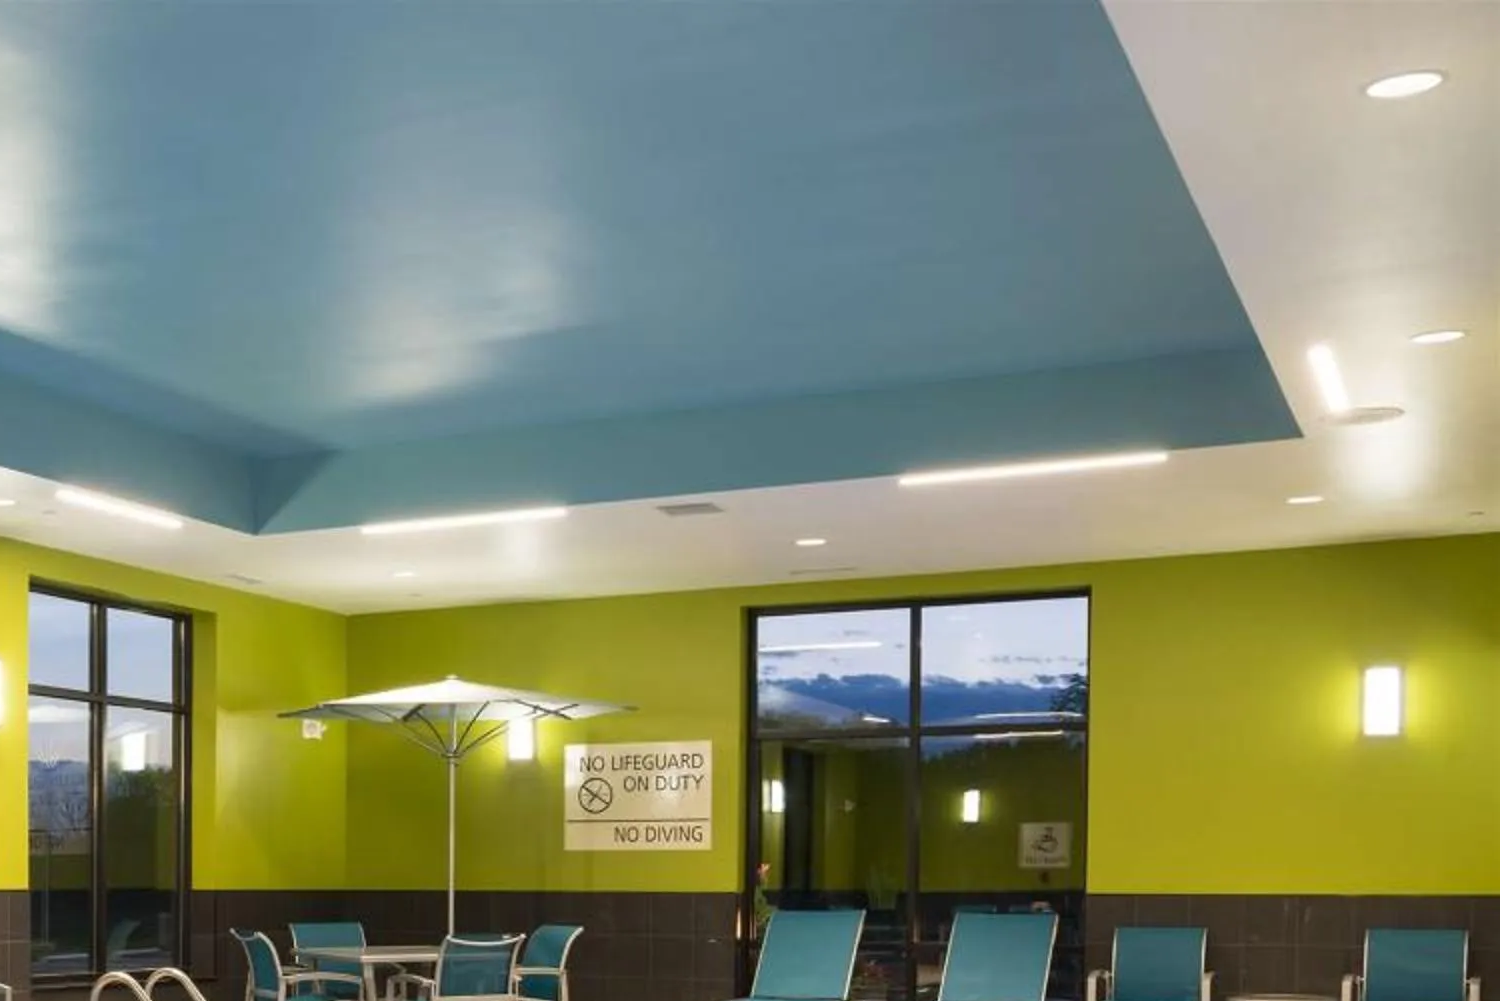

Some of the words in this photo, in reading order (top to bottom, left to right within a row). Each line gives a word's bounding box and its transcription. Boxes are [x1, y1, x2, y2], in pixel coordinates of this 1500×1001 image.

[579, 755, 605, 773] NO
[611, 753, 704, 772] LIFEGUARD
[623, 775, 649, 793] ON
[655, 775, 705, 792] DUTY
[613, 825, 639, 843] NO
[645, 825, 703, 843] DIVING
